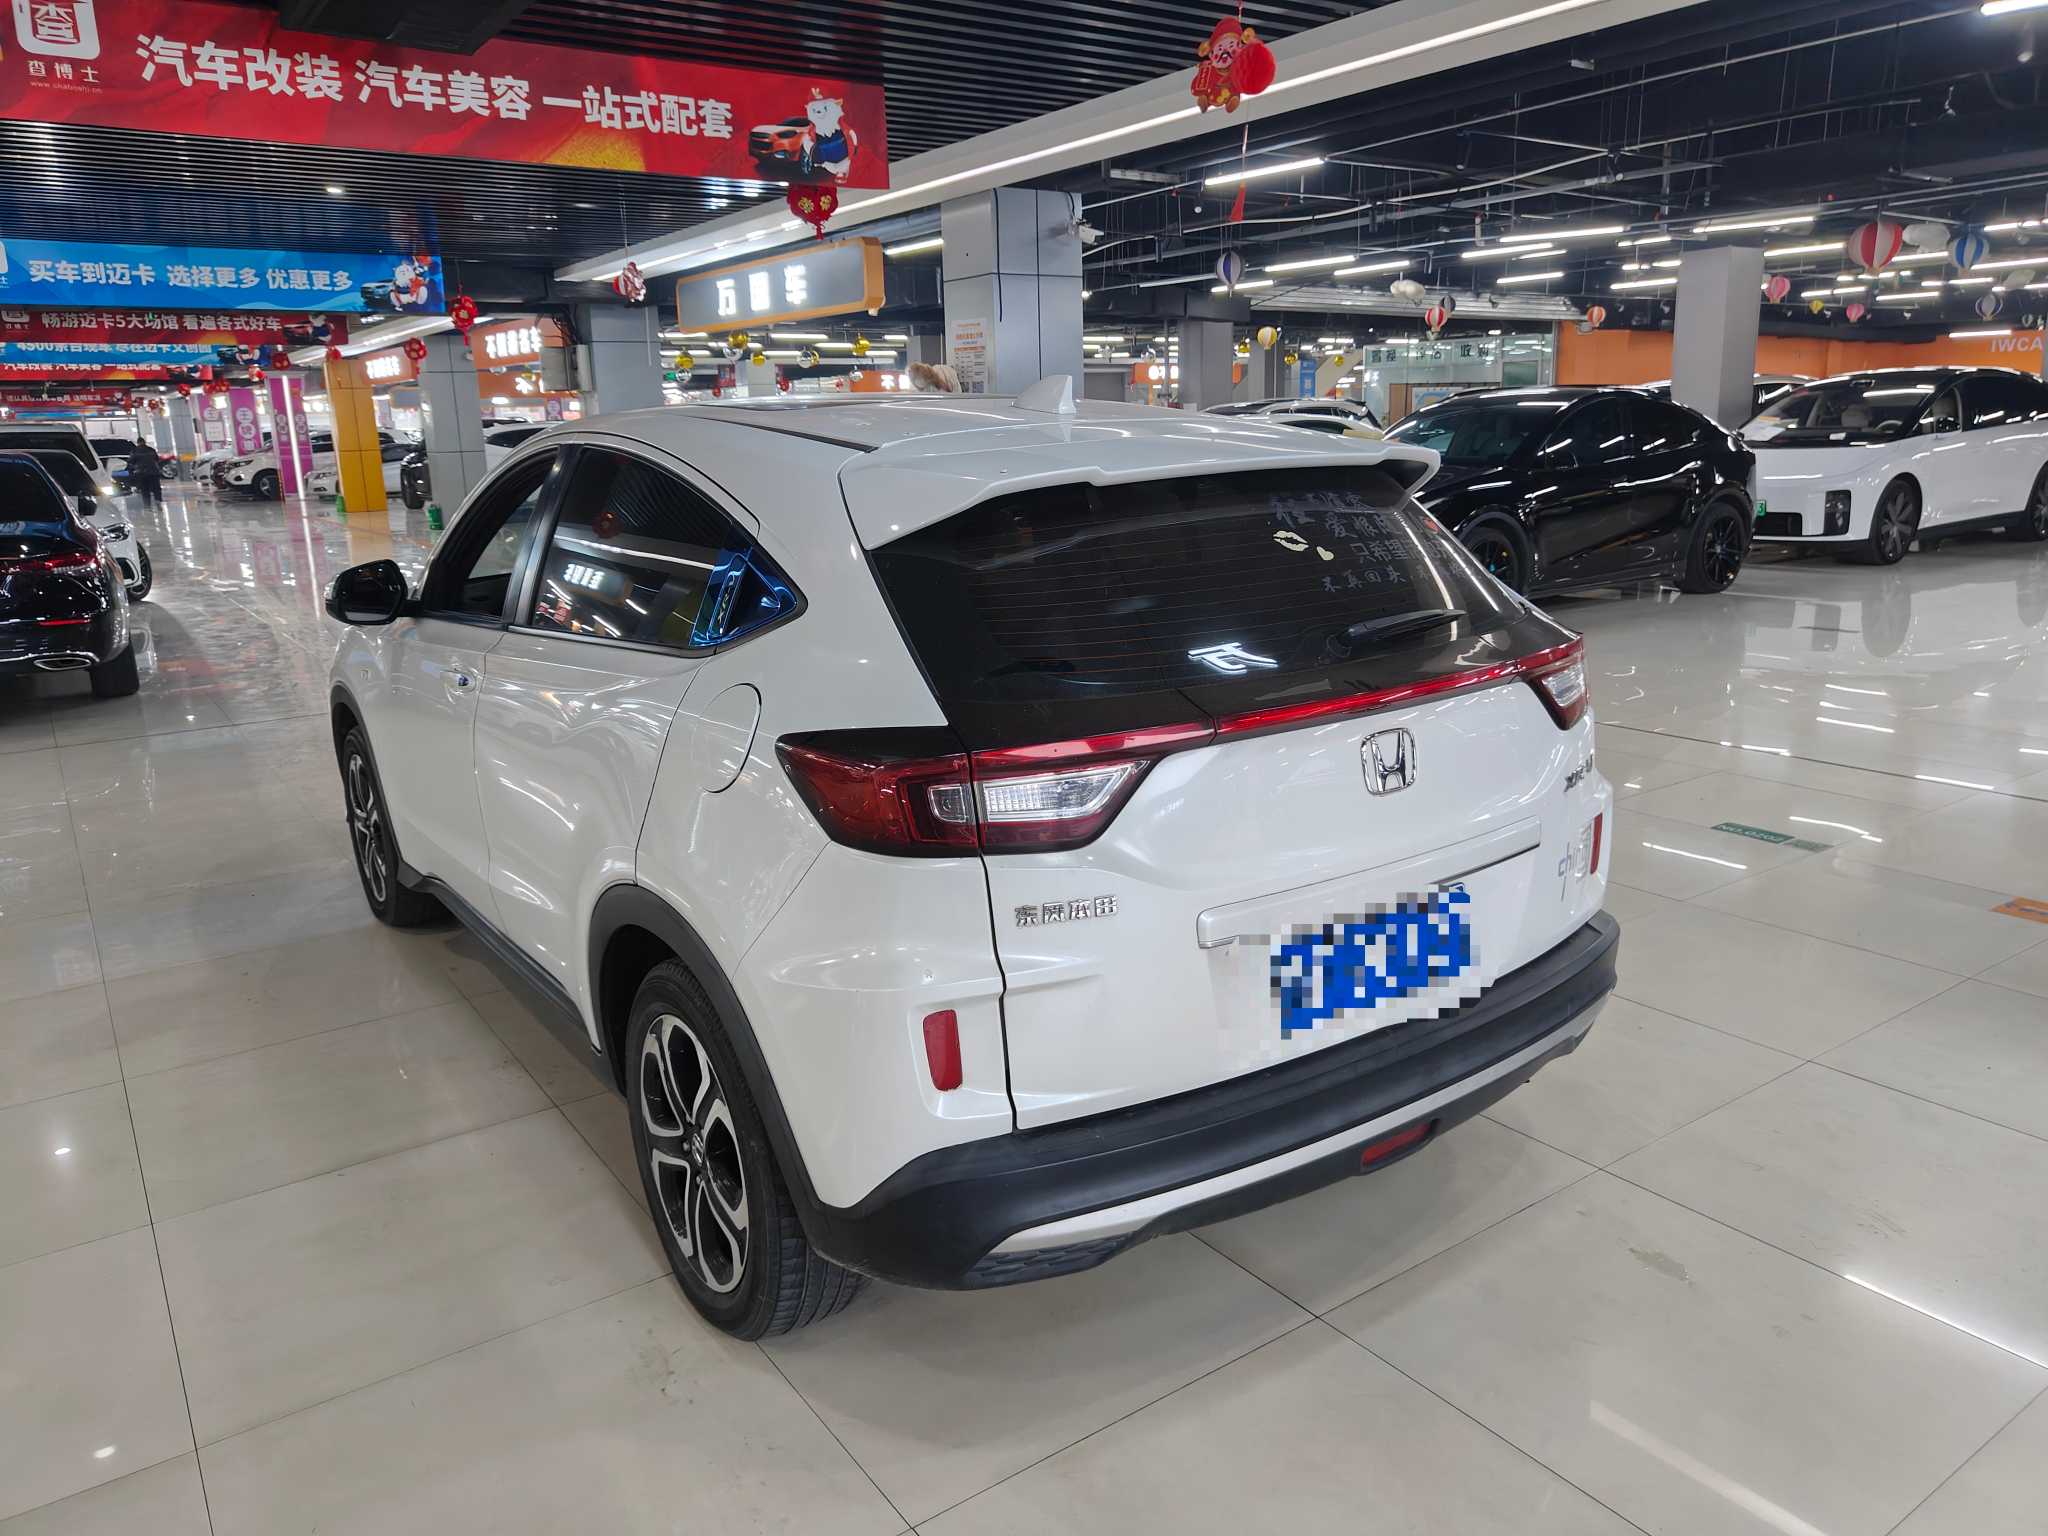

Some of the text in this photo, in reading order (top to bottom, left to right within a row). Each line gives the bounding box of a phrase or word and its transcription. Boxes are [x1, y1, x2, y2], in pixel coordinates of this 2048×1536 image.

[27, 59, 100, 83] 查博士
[136, 34, 734, 139] 汽车改装 汽车美容 一站式配套
[29, 260, 353, 291] 买车到迈卡 选择更多 优惠更多
[42, 312, 282, 332] 畅游迈卡5大场馆 看遍各式好车
[1014, 894, 1119, 928] 东风本田
